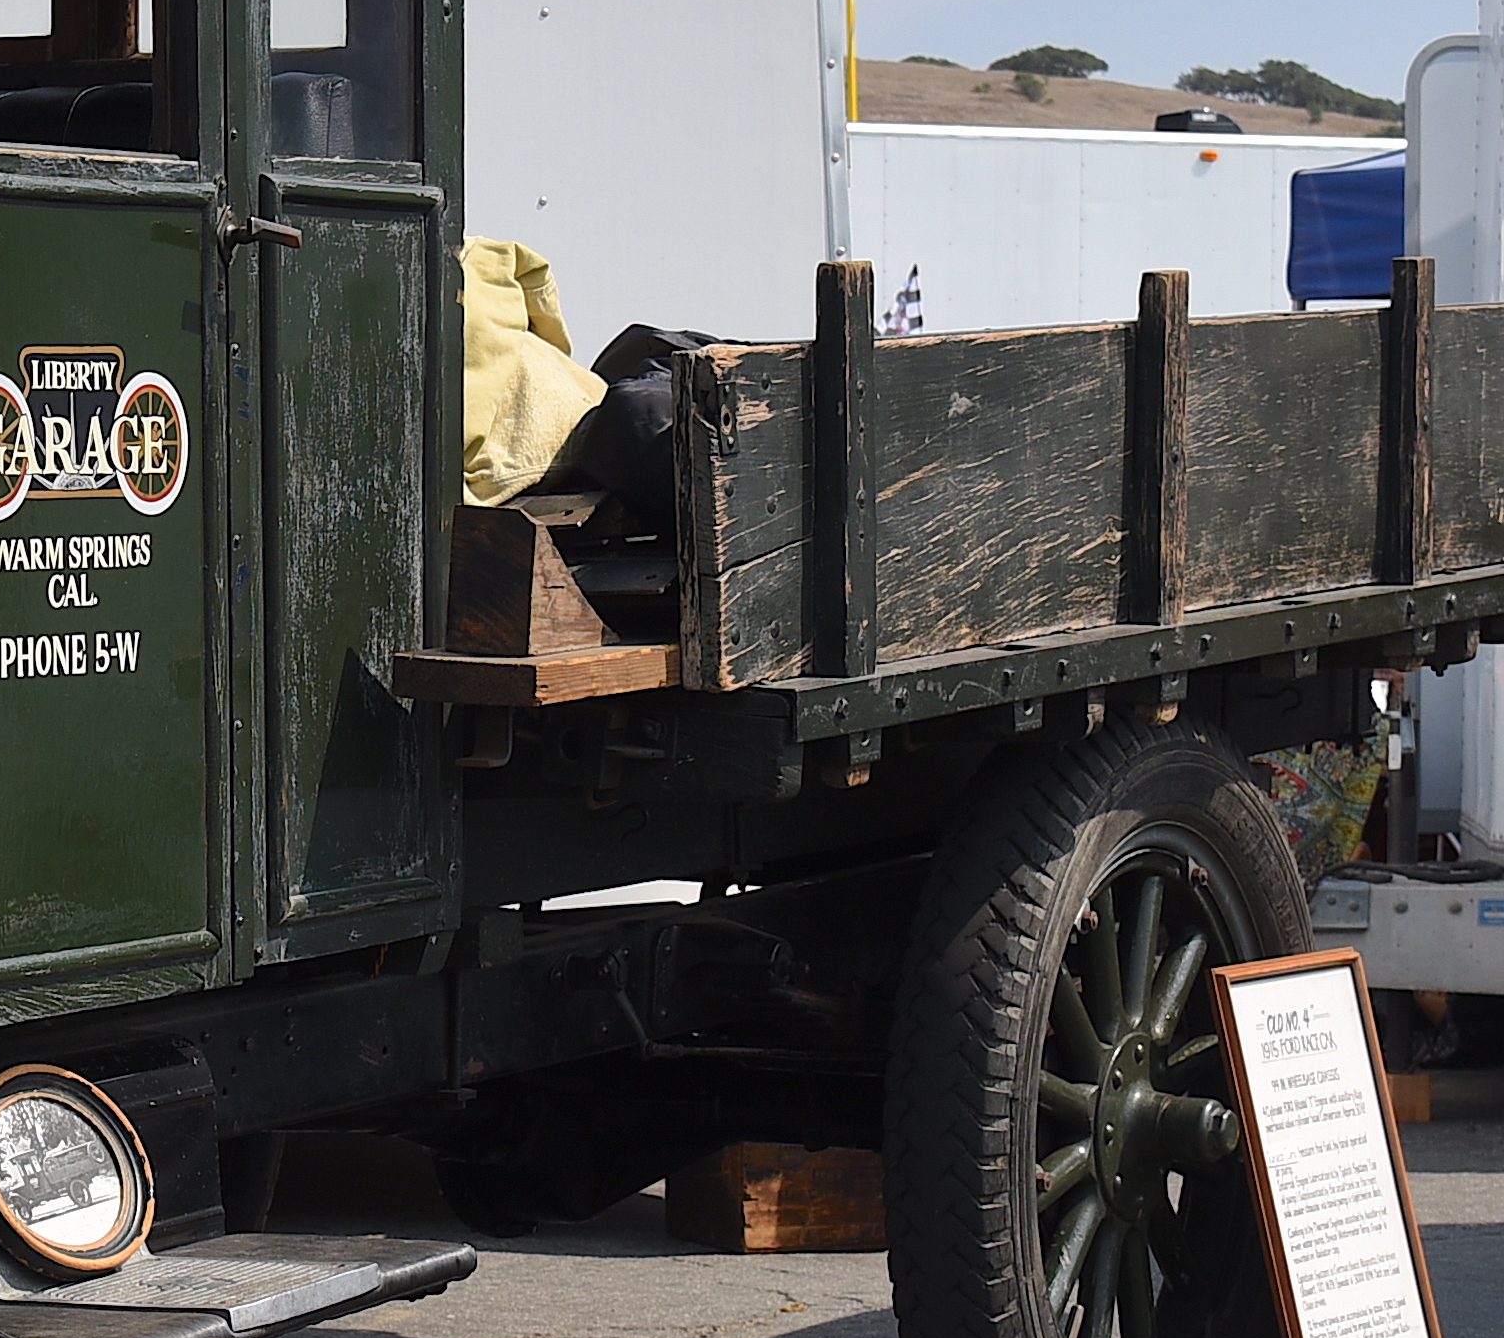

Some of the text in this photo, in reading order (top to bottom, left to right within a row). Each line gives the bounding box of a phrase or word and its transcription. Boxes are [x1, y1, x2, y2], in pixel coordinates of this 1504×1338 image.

[31, 359, 117, 391] LIBERTY
[68, 534, 151, 569] SPRINGS
[47, 575, 99, 608] CAL.
[0, 631, 141, 679] PHONE 5-W
[1259, 1038, 1280, 1060] 1915
